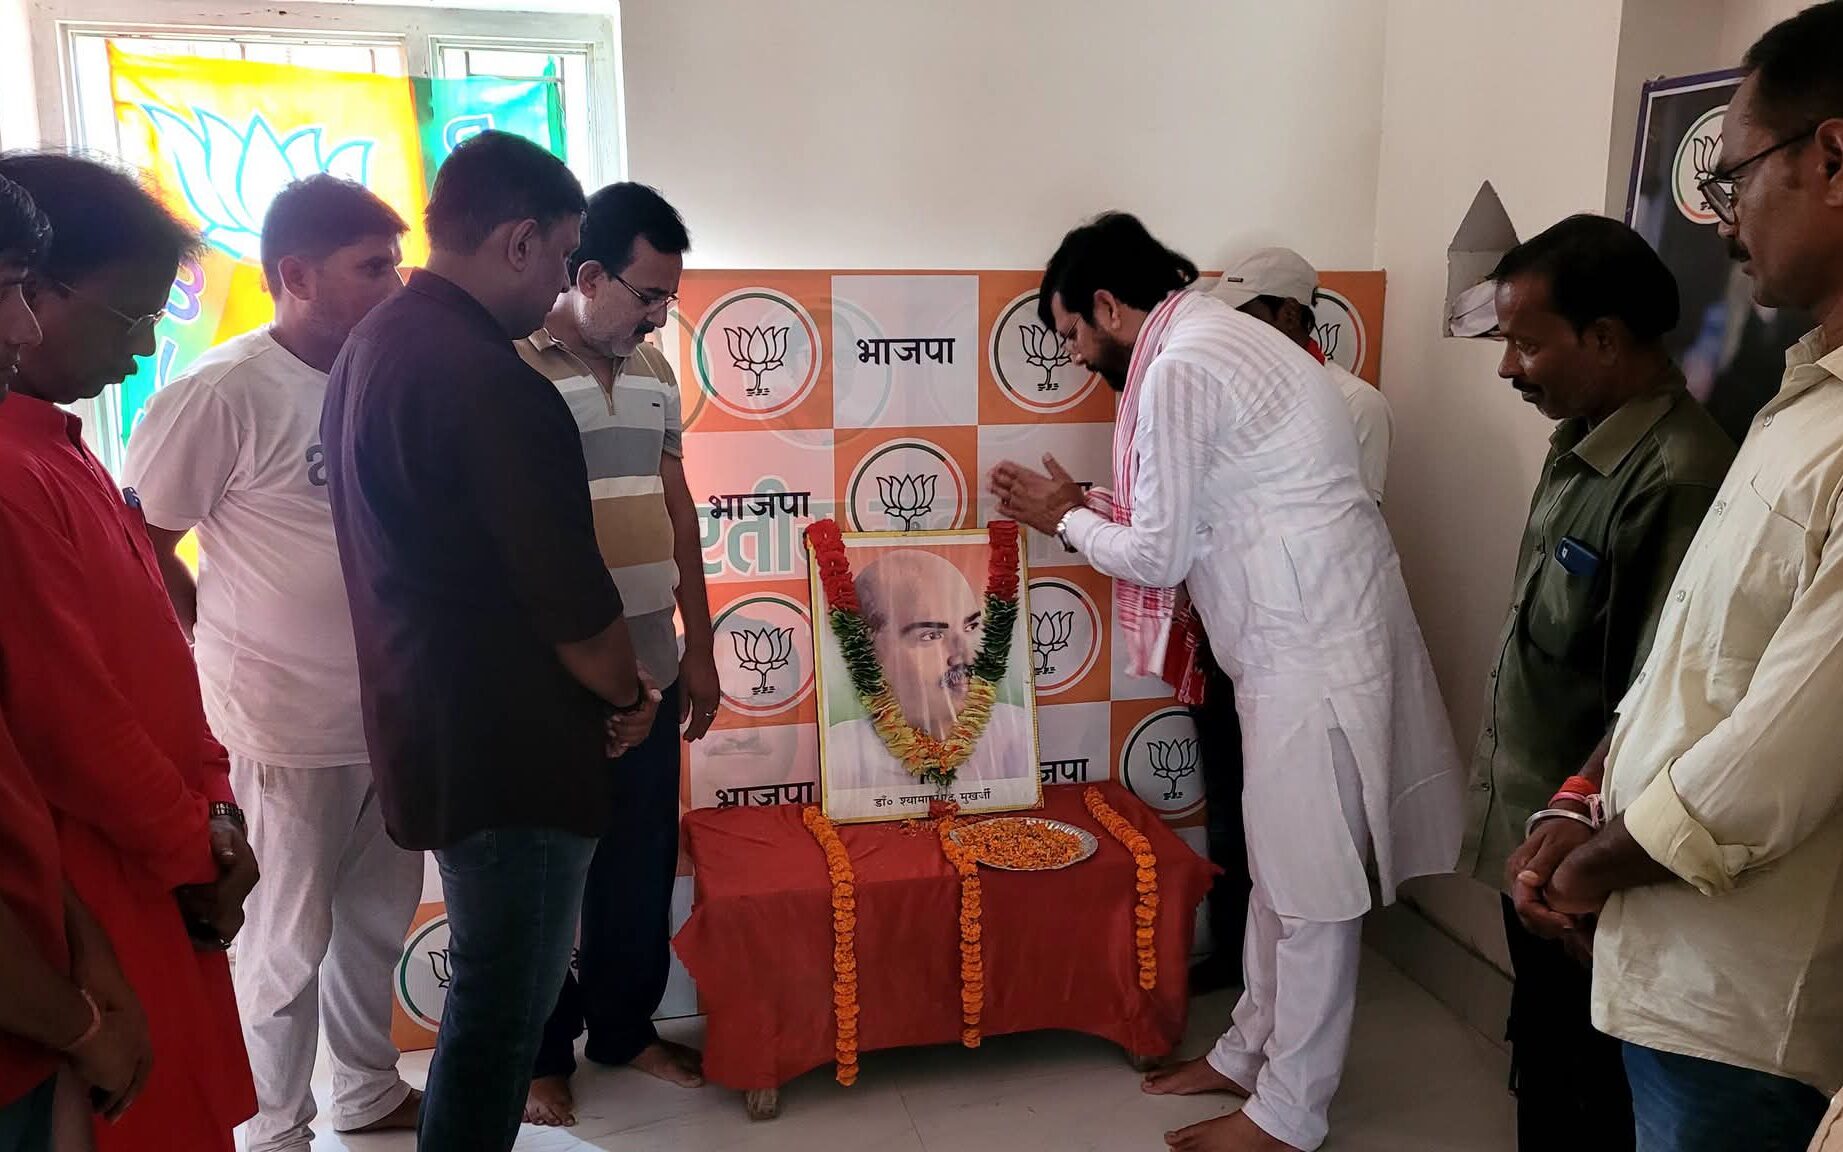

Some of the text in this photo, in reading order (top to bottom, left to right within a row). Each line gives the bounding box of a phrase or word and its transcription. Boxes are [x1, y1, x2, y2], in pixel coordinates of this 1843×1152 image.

[856, 337, 956, 366] भाजपा
[709, 491, 811, 521] भाजपा
[1040, 758, 1090, 784] जपा
[715, 781, 815, 808] भाजपा
